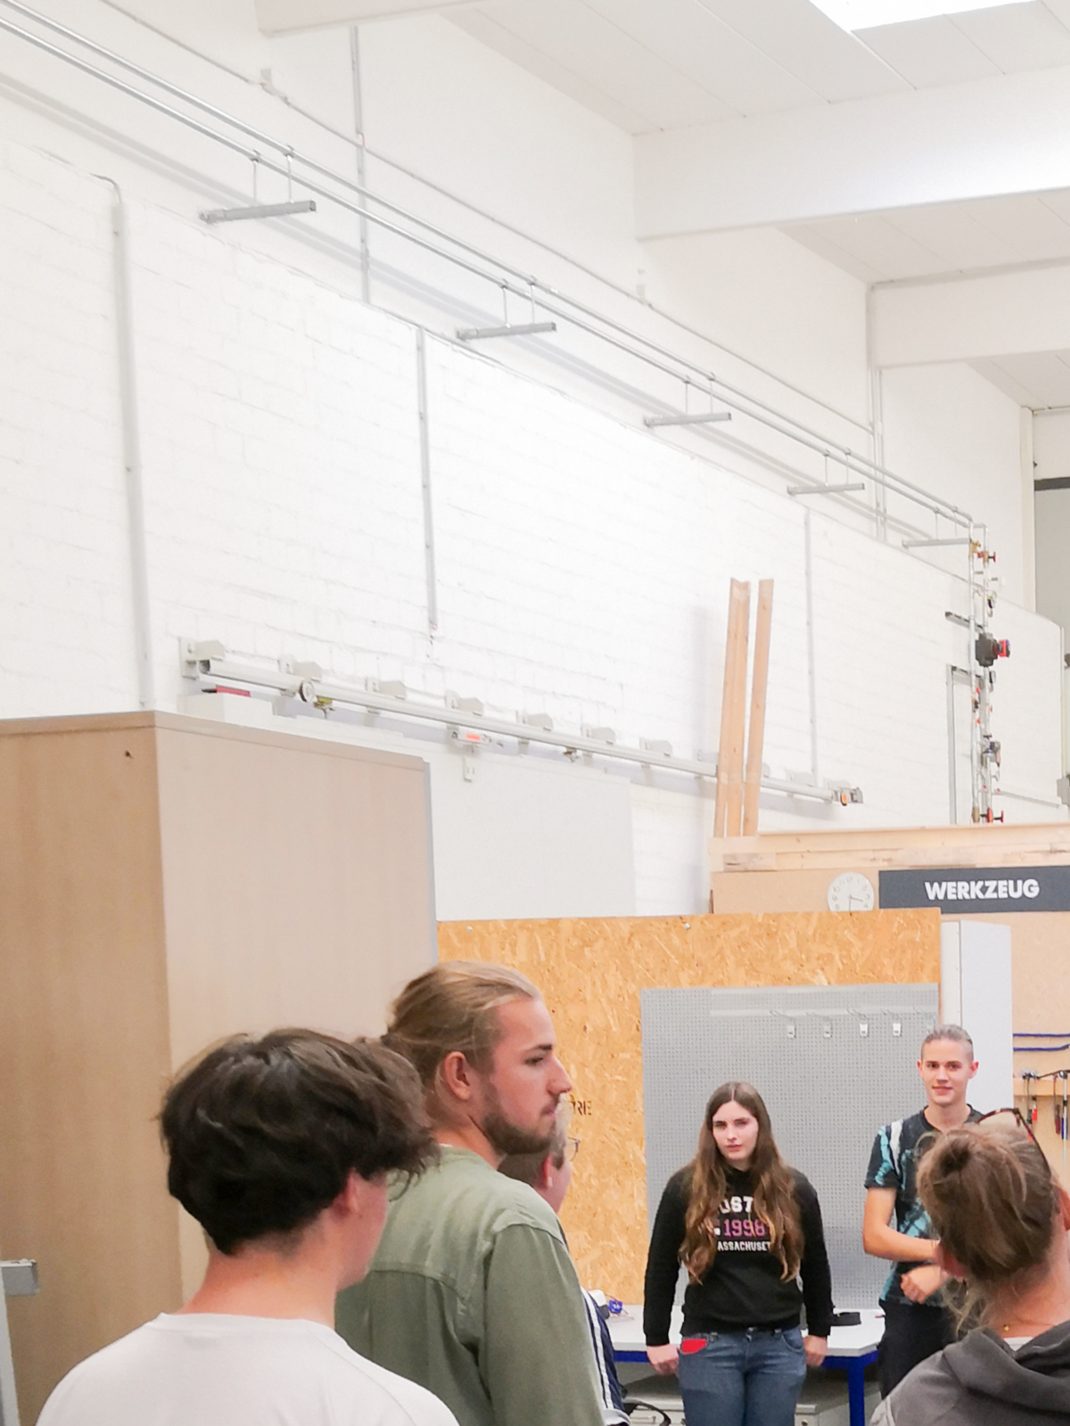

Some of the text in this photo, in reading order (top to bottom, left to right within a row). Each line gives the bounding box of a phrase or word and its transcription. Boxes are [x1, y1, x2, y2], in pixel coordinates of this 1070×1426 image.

[924, 879, 1040, 900] WERKZEUG
[723, 1219, 766, 1238] 1998
[717, 1241, 771, 1252] ASSACHUSET
